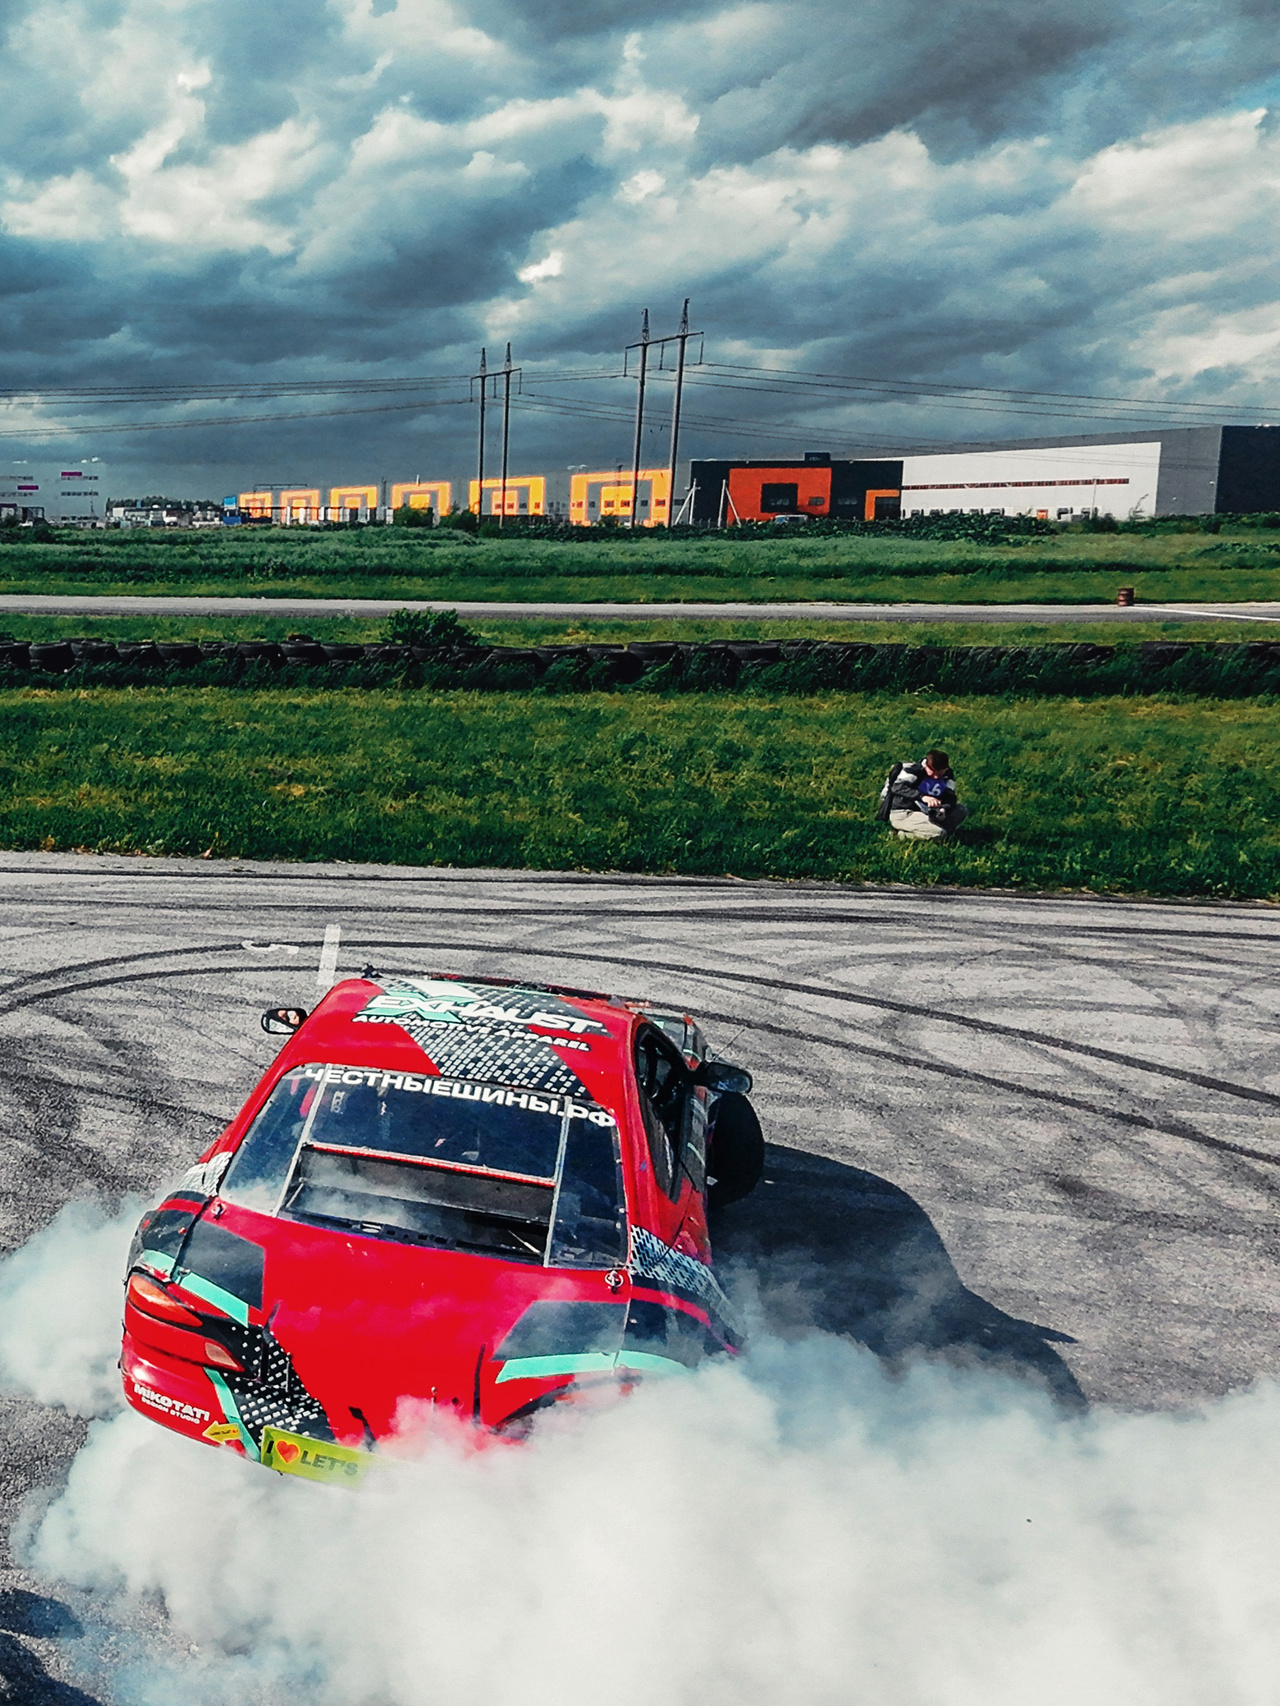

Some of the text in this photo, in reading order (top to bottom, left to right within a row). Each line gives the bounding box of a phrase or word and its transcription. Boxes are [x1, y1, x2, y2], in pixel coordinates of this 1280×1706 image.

[364, 990, 604, 1034] EXHAUST
[351, 1014, 592, 1052] AUTOMOTIVE APPAREL
[305, 1068, 616, 1128] ЧЕСТНЫЕШИНЫ.РФ
[170, 1409, 200, 1425] STUDIO
[300, 1450, 358, 1477] LET'S
